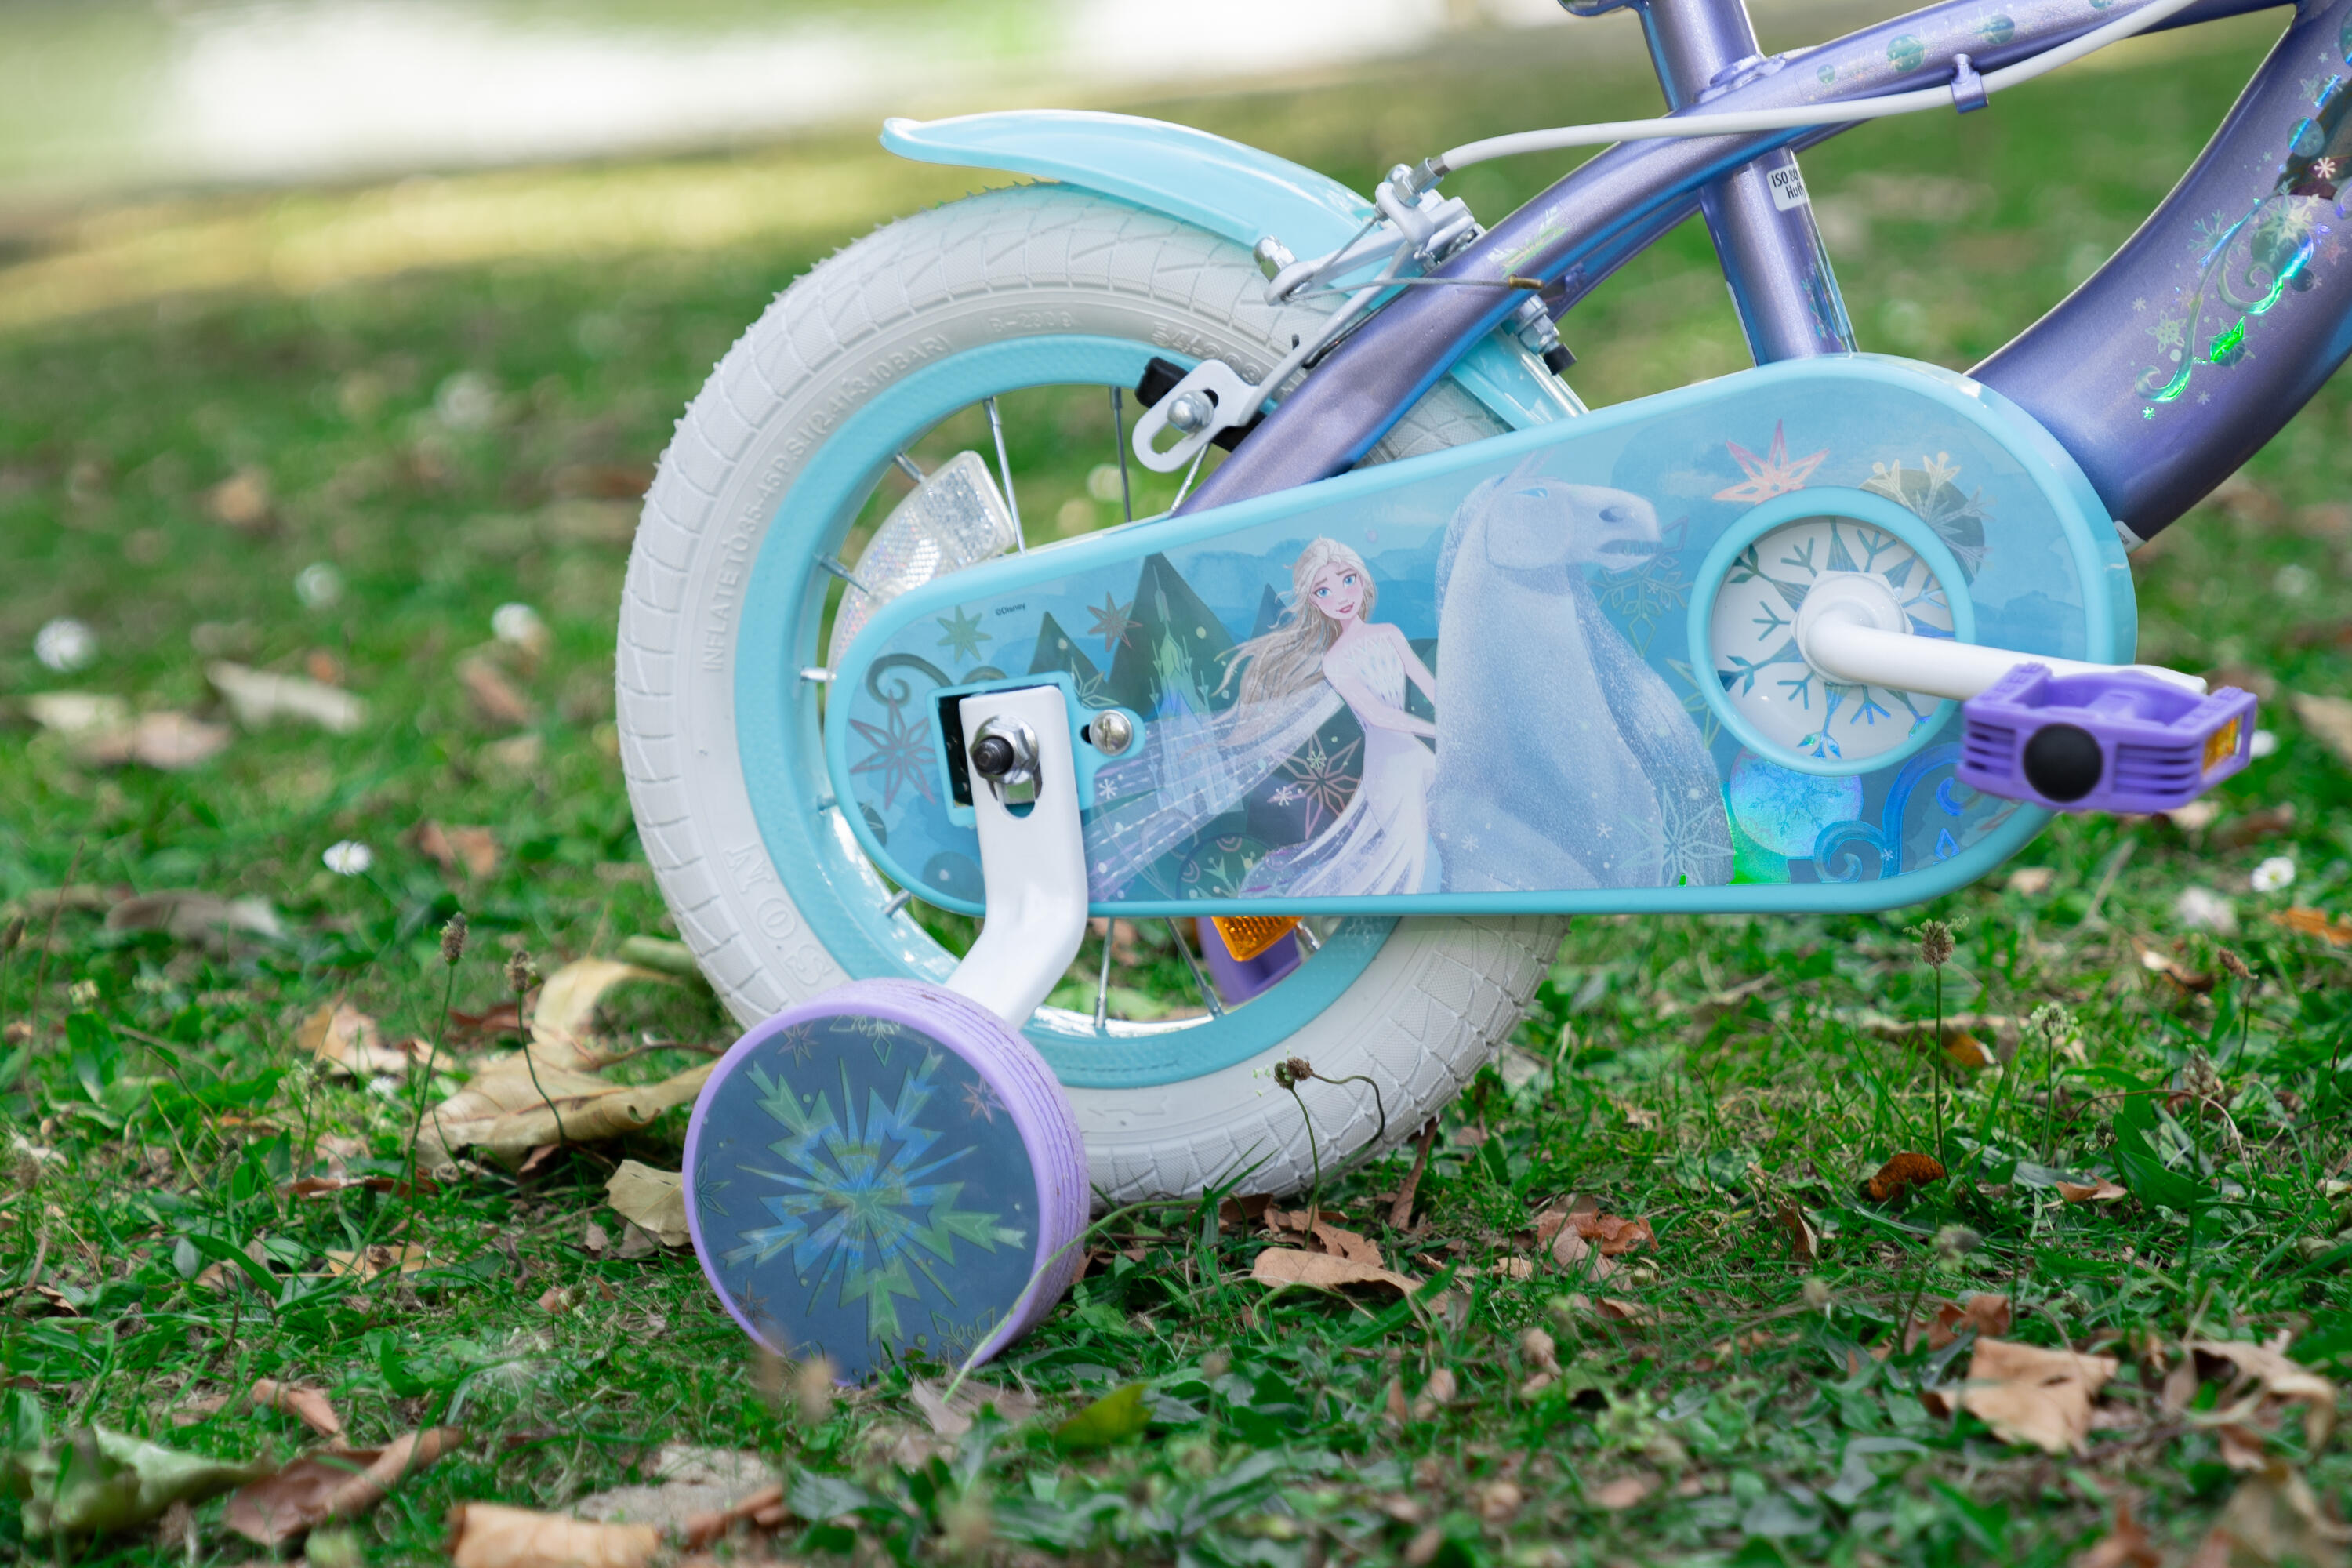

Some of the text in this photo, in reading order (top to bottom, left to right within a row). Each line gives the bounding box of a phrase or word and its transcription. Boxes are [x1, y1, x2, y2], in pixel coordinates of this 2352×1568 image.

[1771, 168, 1800, 188] ISO 80
[1785, 182, 1805, 199] Huff
